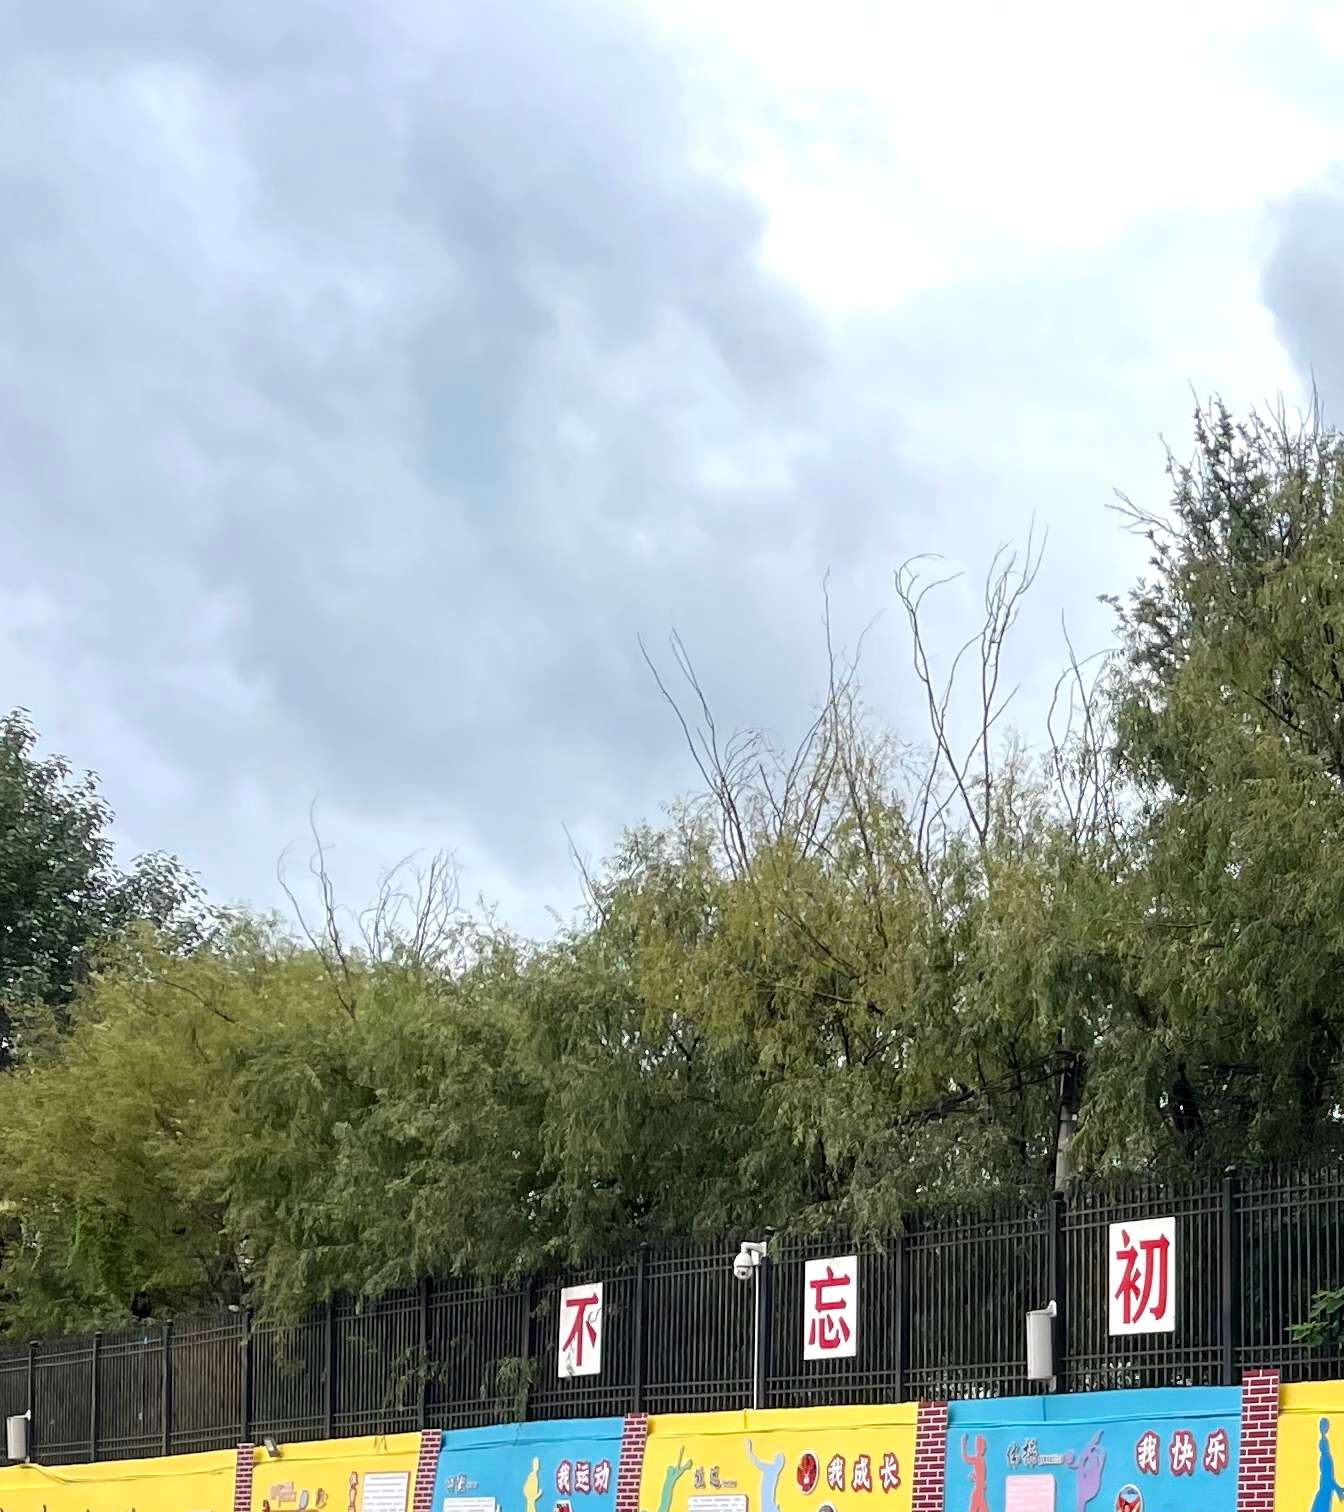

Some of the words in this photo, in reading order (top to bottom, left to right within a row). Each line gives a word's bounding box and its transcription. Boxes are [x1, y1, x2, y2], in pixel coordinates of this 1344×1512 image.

[807, 1265, 851, 1350] 忘
[1114, 1229, 1170, 1325] 初
[562, 1292, 598, 1368] 不
[557, 1460, 611, 1495] 我运动
[826, 1452, 901, 1493] 我成长
[1136, 1428, 1230, 1476] 我快乐
